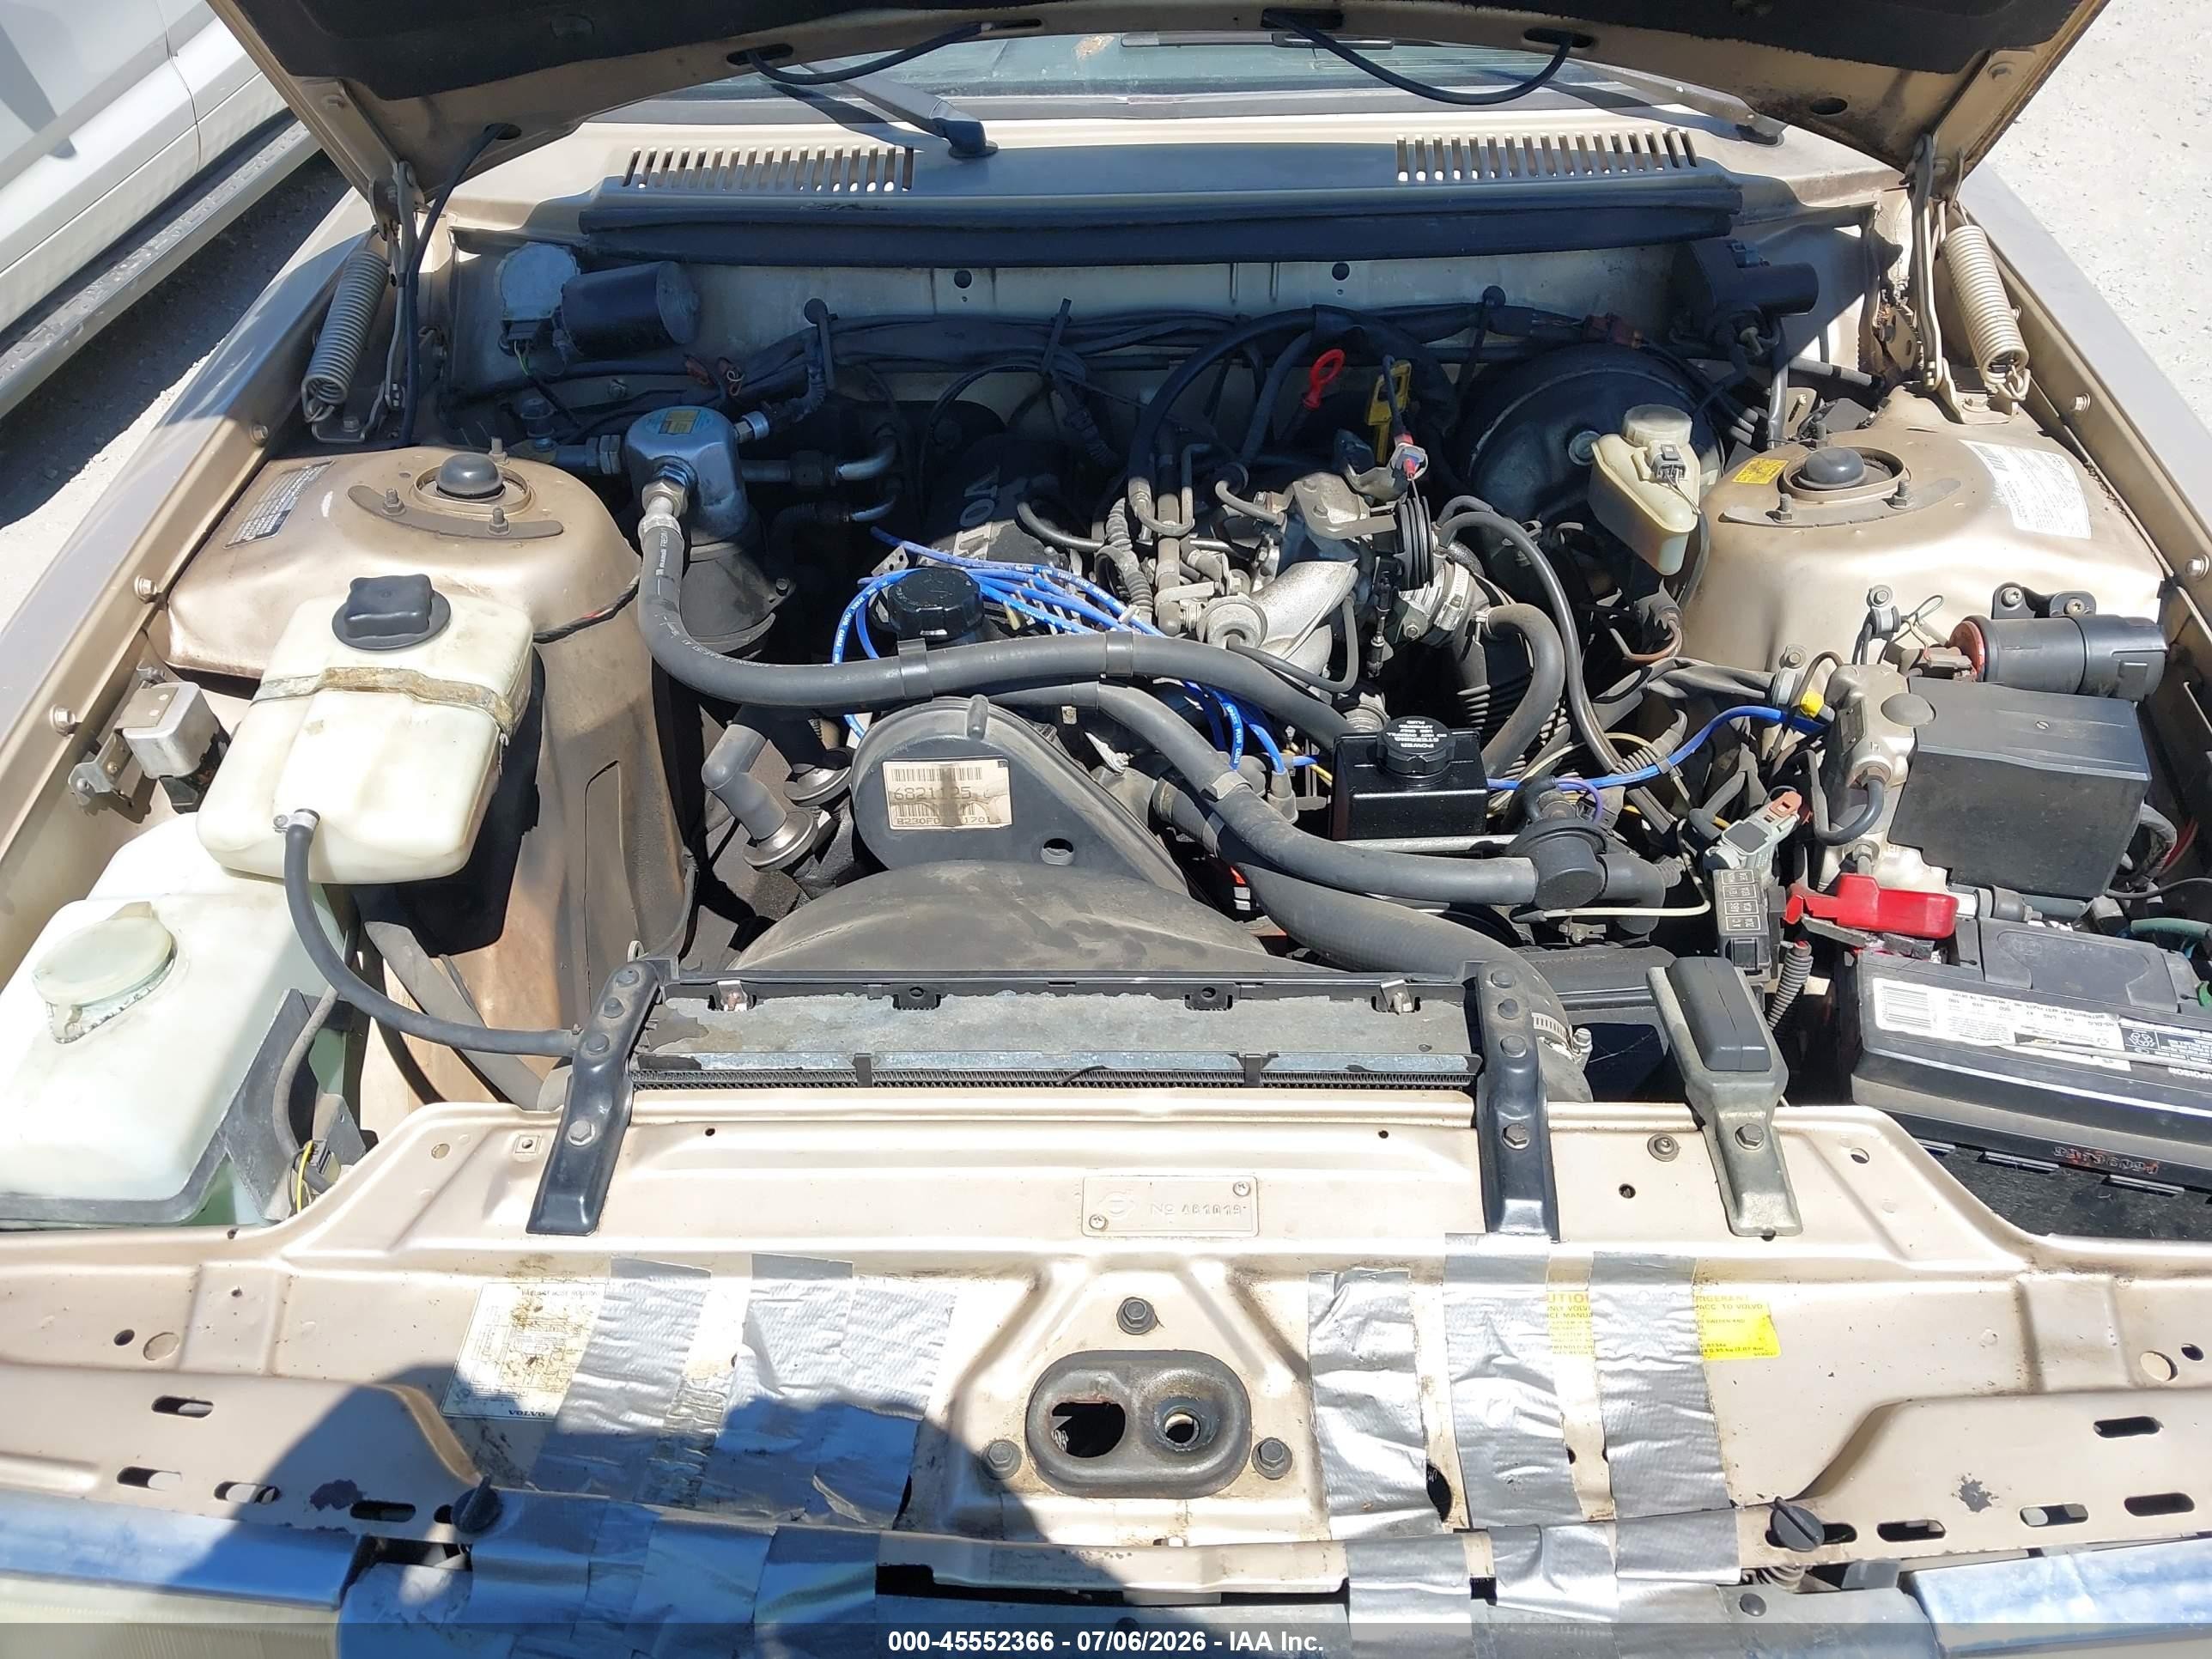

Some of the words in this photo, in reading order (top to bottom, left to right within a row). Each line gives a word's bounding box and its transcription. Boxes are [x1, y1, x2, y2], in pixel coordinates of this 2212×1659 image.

[836, 629, 845, 647] CABLE
[894, 787, 972, 800] 6821125
[1730, 902, 1740, 913] ABS
